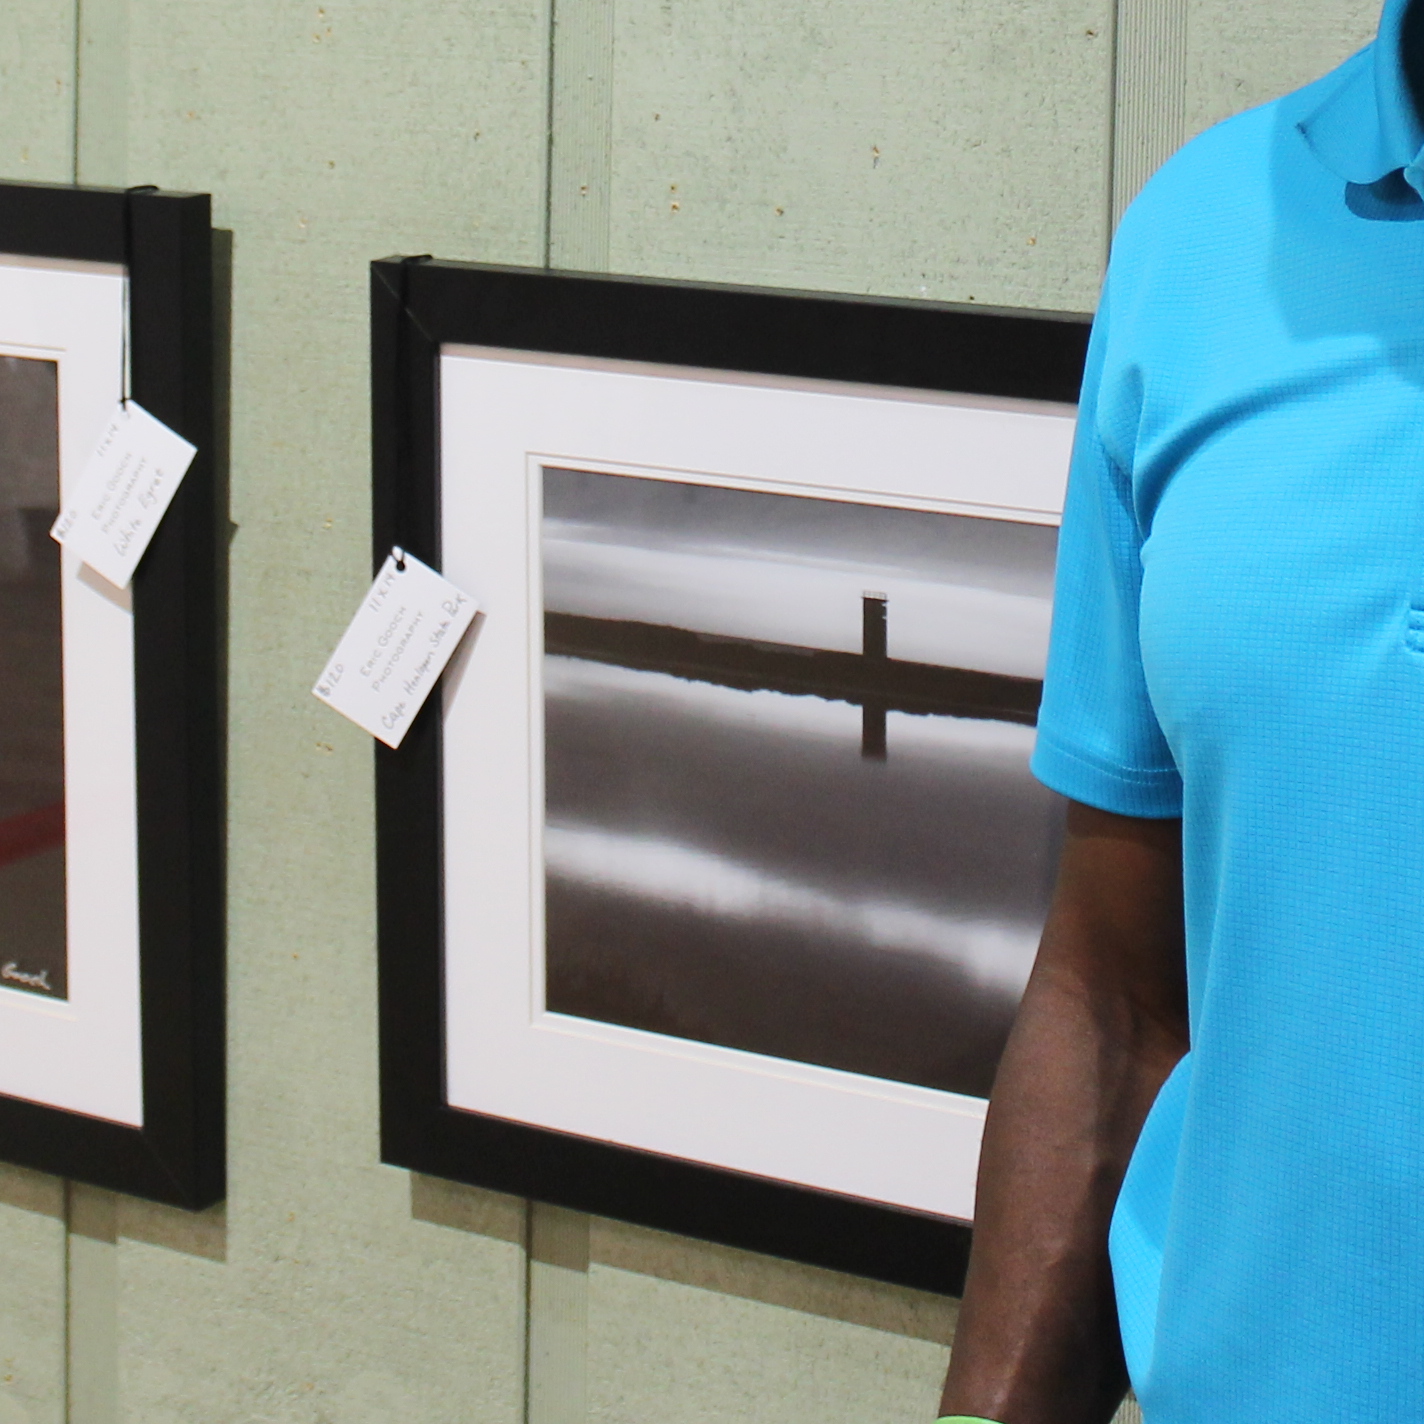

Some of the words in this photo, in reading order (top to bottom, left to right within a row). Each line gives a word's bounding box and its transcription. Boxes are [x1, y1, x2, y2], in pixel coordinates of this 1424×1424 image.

[91, 494, 110, 520] ERIC
[107, 452, 132, 491] GOOCH
[101, 457, 146, 534] PHOTOGRAPHY
[114, 519, 141, 557] White
[139, 469, 164, 509] Egret
[360, 650, 382, 677] ERIC
[378, 606, 406, 647] GOOCH
[372, 611, 423, 692] PHOTOGRAPHY
[318, 664, 343, 696] $120
[382, 703, 406, 729] Cape
